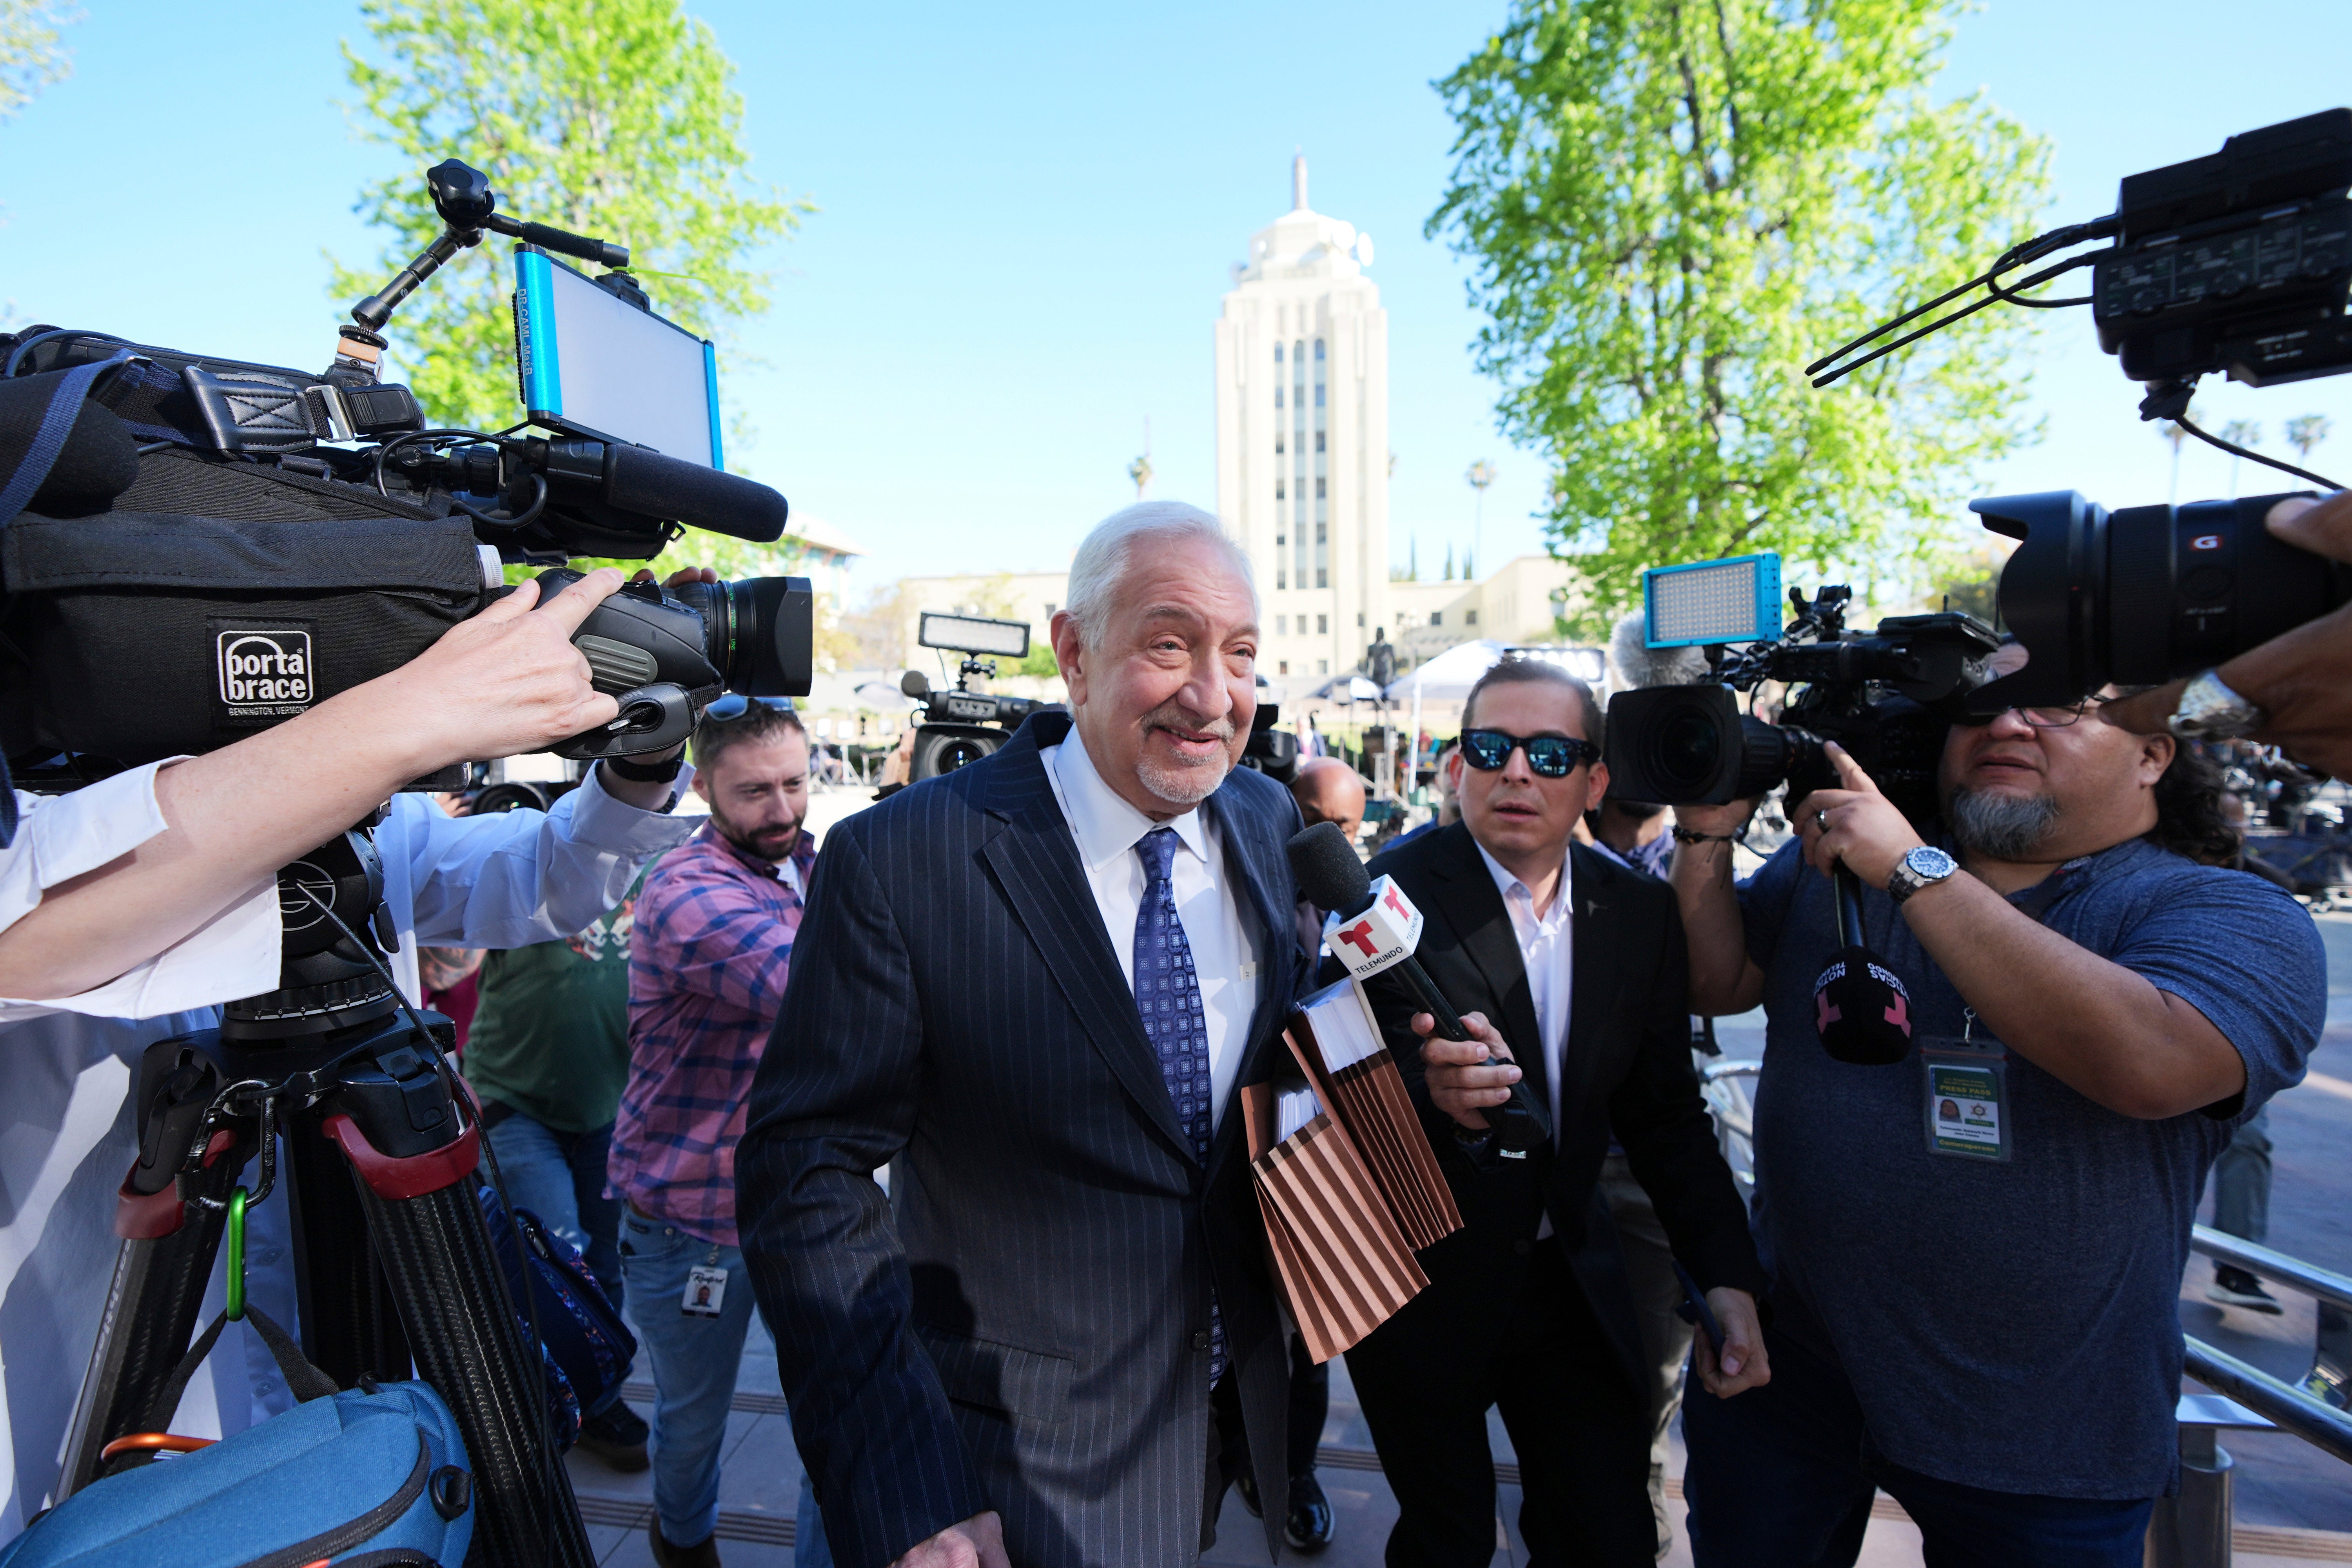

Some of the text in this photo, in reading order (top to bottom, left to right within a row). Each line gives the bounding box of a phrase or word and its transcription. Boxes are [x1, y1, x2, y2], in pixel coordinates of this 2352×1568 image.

[519, 288, 533, 376] DR-CAML-MaxB
[2194, 535, 2218, 550] G
[225, 653, 305, 675] porta
[229, 678, 306, 700] brace
[1354, 946, 1403, 974] TELEMUNDO
[425, 1030, 434, 1044] JAPAN
[438, 1051, 448, 1064] MADE
[1940, 1085, 1967, 1093] PRESS
[1939, 1139, 1996, 1152] Cameraperson
